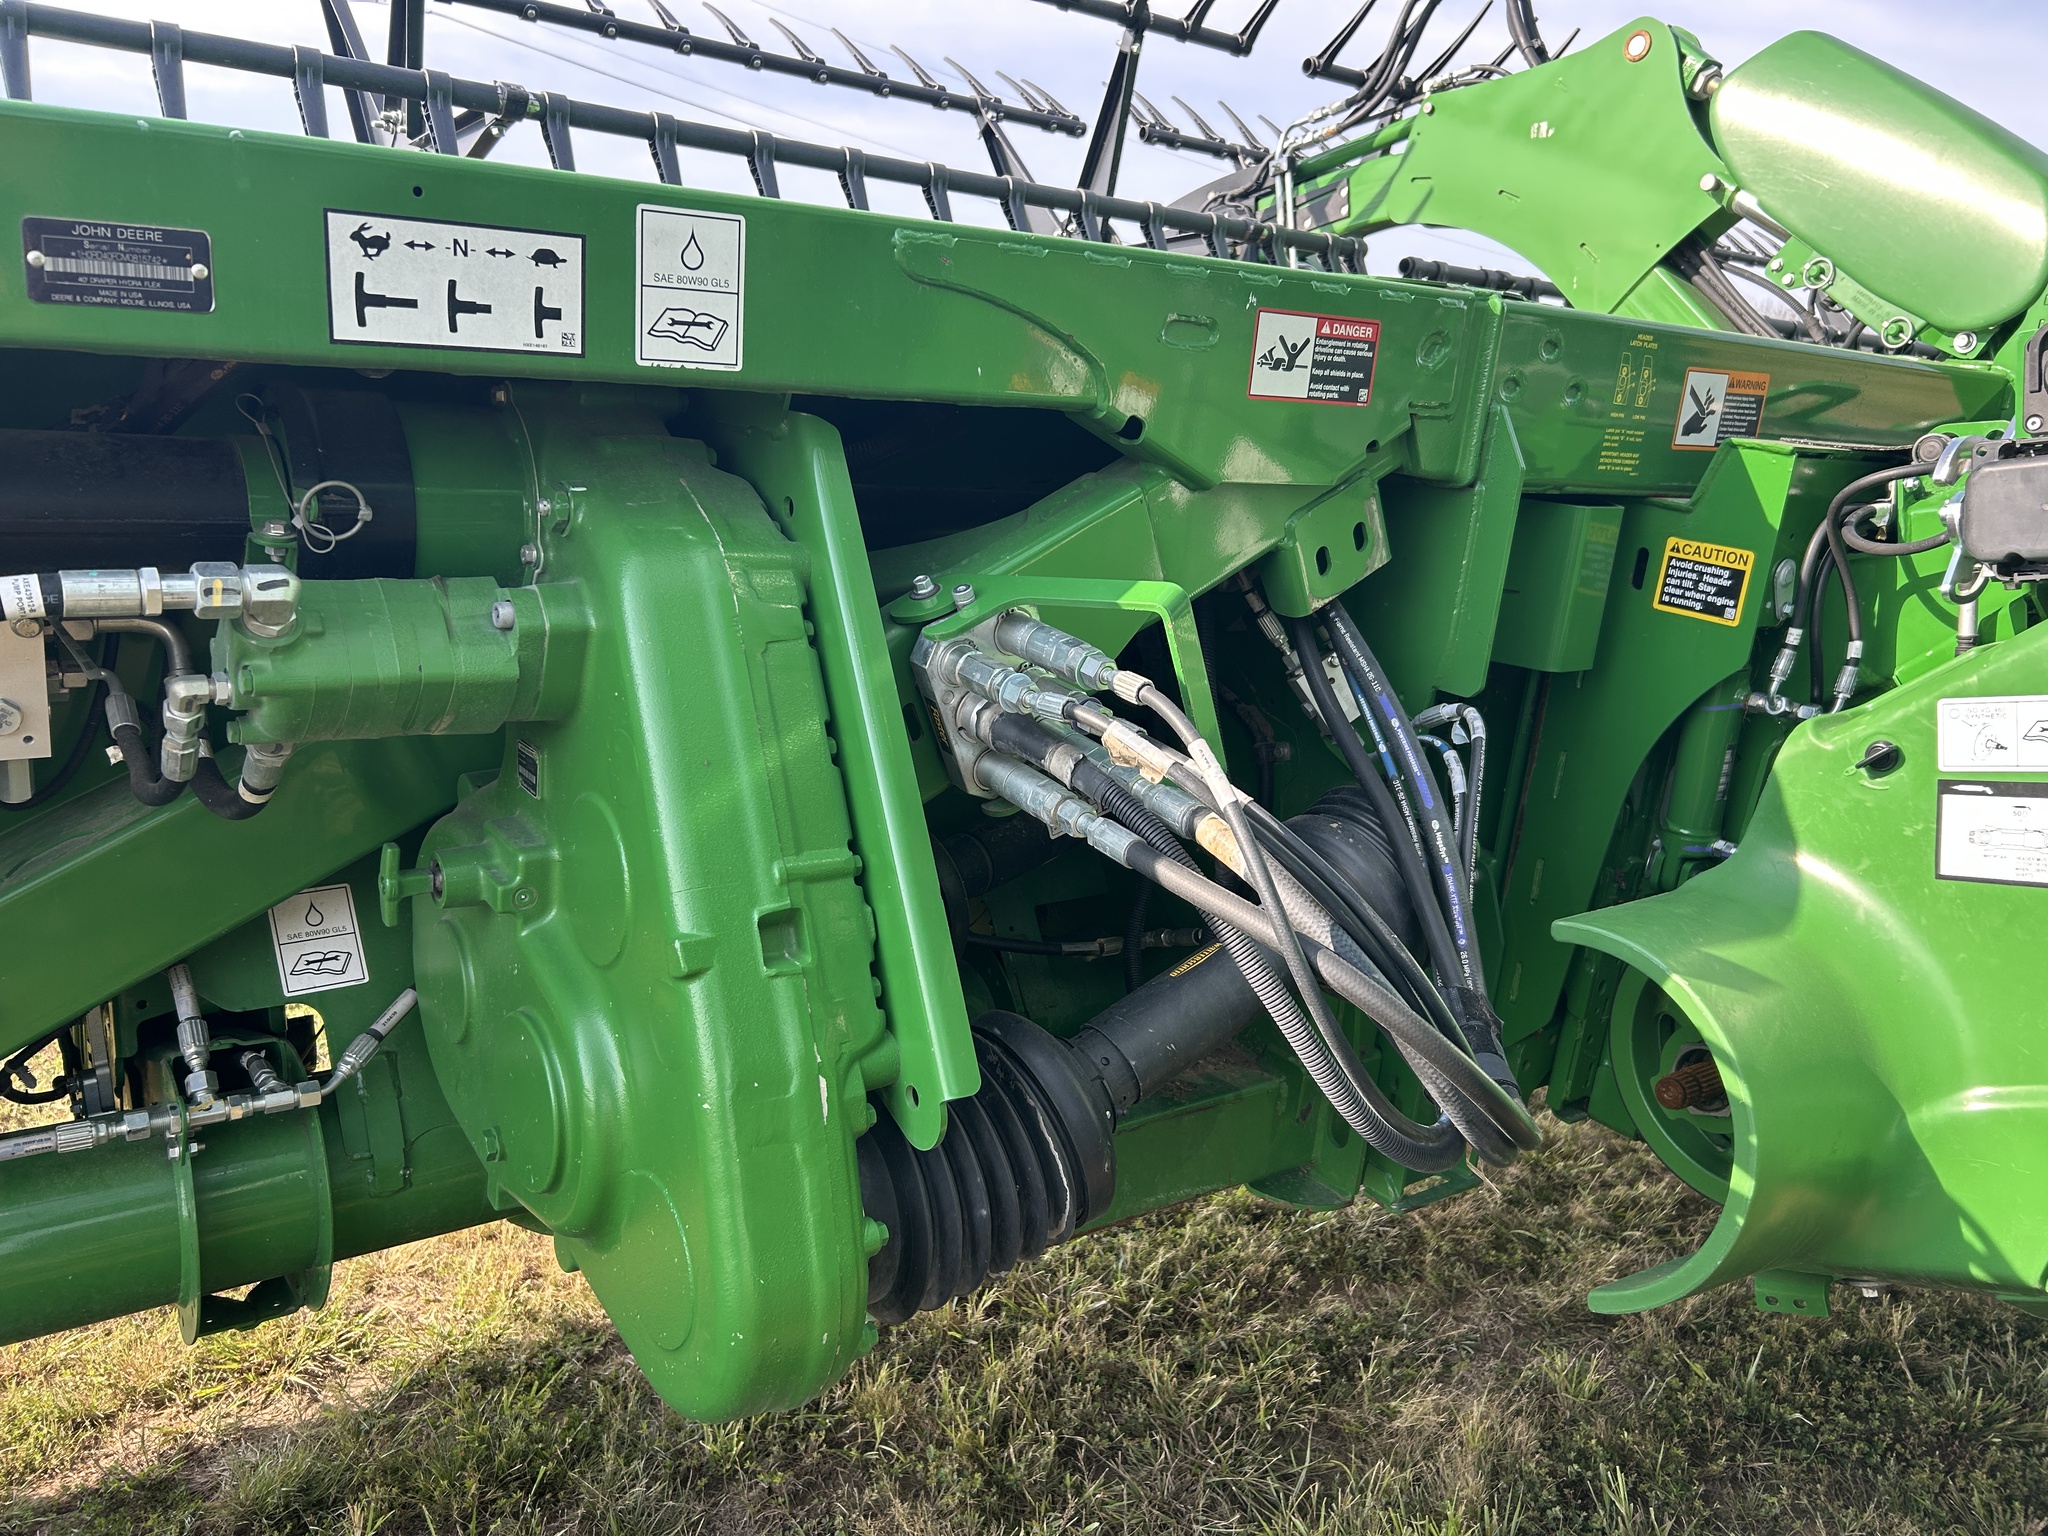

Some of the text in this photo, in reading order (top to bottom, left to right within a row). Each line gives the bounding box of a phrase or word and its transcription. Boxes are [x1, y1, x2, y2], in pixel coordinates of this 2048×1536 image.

[72, 224, 163, 242] JOHN DEERE
[90, 277, 117, 285] DRAPER
[119, 279, 142, 287] HYDRA
[653, 273, 730, 288] SAE 80W90 GL5
[51, 293, 74, 302] DEERE
[1332, 323, 1373, 338] DANGER
[1316, 337, 1346, 347] Entanglement
[1351, 341, 1368, 350] rotating
[1314, 353, 1327, 362] injury
[1315, 346, 1334, 354] driveline
[1357, 350, 1373, 358] serious
[1312, 368, 1323, 377] Keep
[1351, 371, 1364, 379] place.
[1310, 382, 1322, 390] Avoid
[1340, 384, 1350, 392] with
[1735, 379, 1766, 391] WARNING
[1308, 390, 1326, 400] rotating
[1682, 543, 1749, 567] CAUTION
[1670, 558, 1730, 578] Avoid crushing
[1668, 567, 1732, 587] injuries. Header
[1666, 577, 1716, 595] can tilt. Stay
[1662, 593, 1703, 611] is running.
[1664, 586, 1734, 607] clear when engine
[16, 597, 27, 614] PORT
[1344, 632, 1361, 658] Resistant
[1358, 656, 1370, 673] MSHA
[1400, 800, 1411, 817] MSHA
[1406, 816, 1419, 843] Resistant
[287, 925, 347, 941] SAE 80W90 GL5
[1460, 950, 1470, 977] 26.0 MPa
